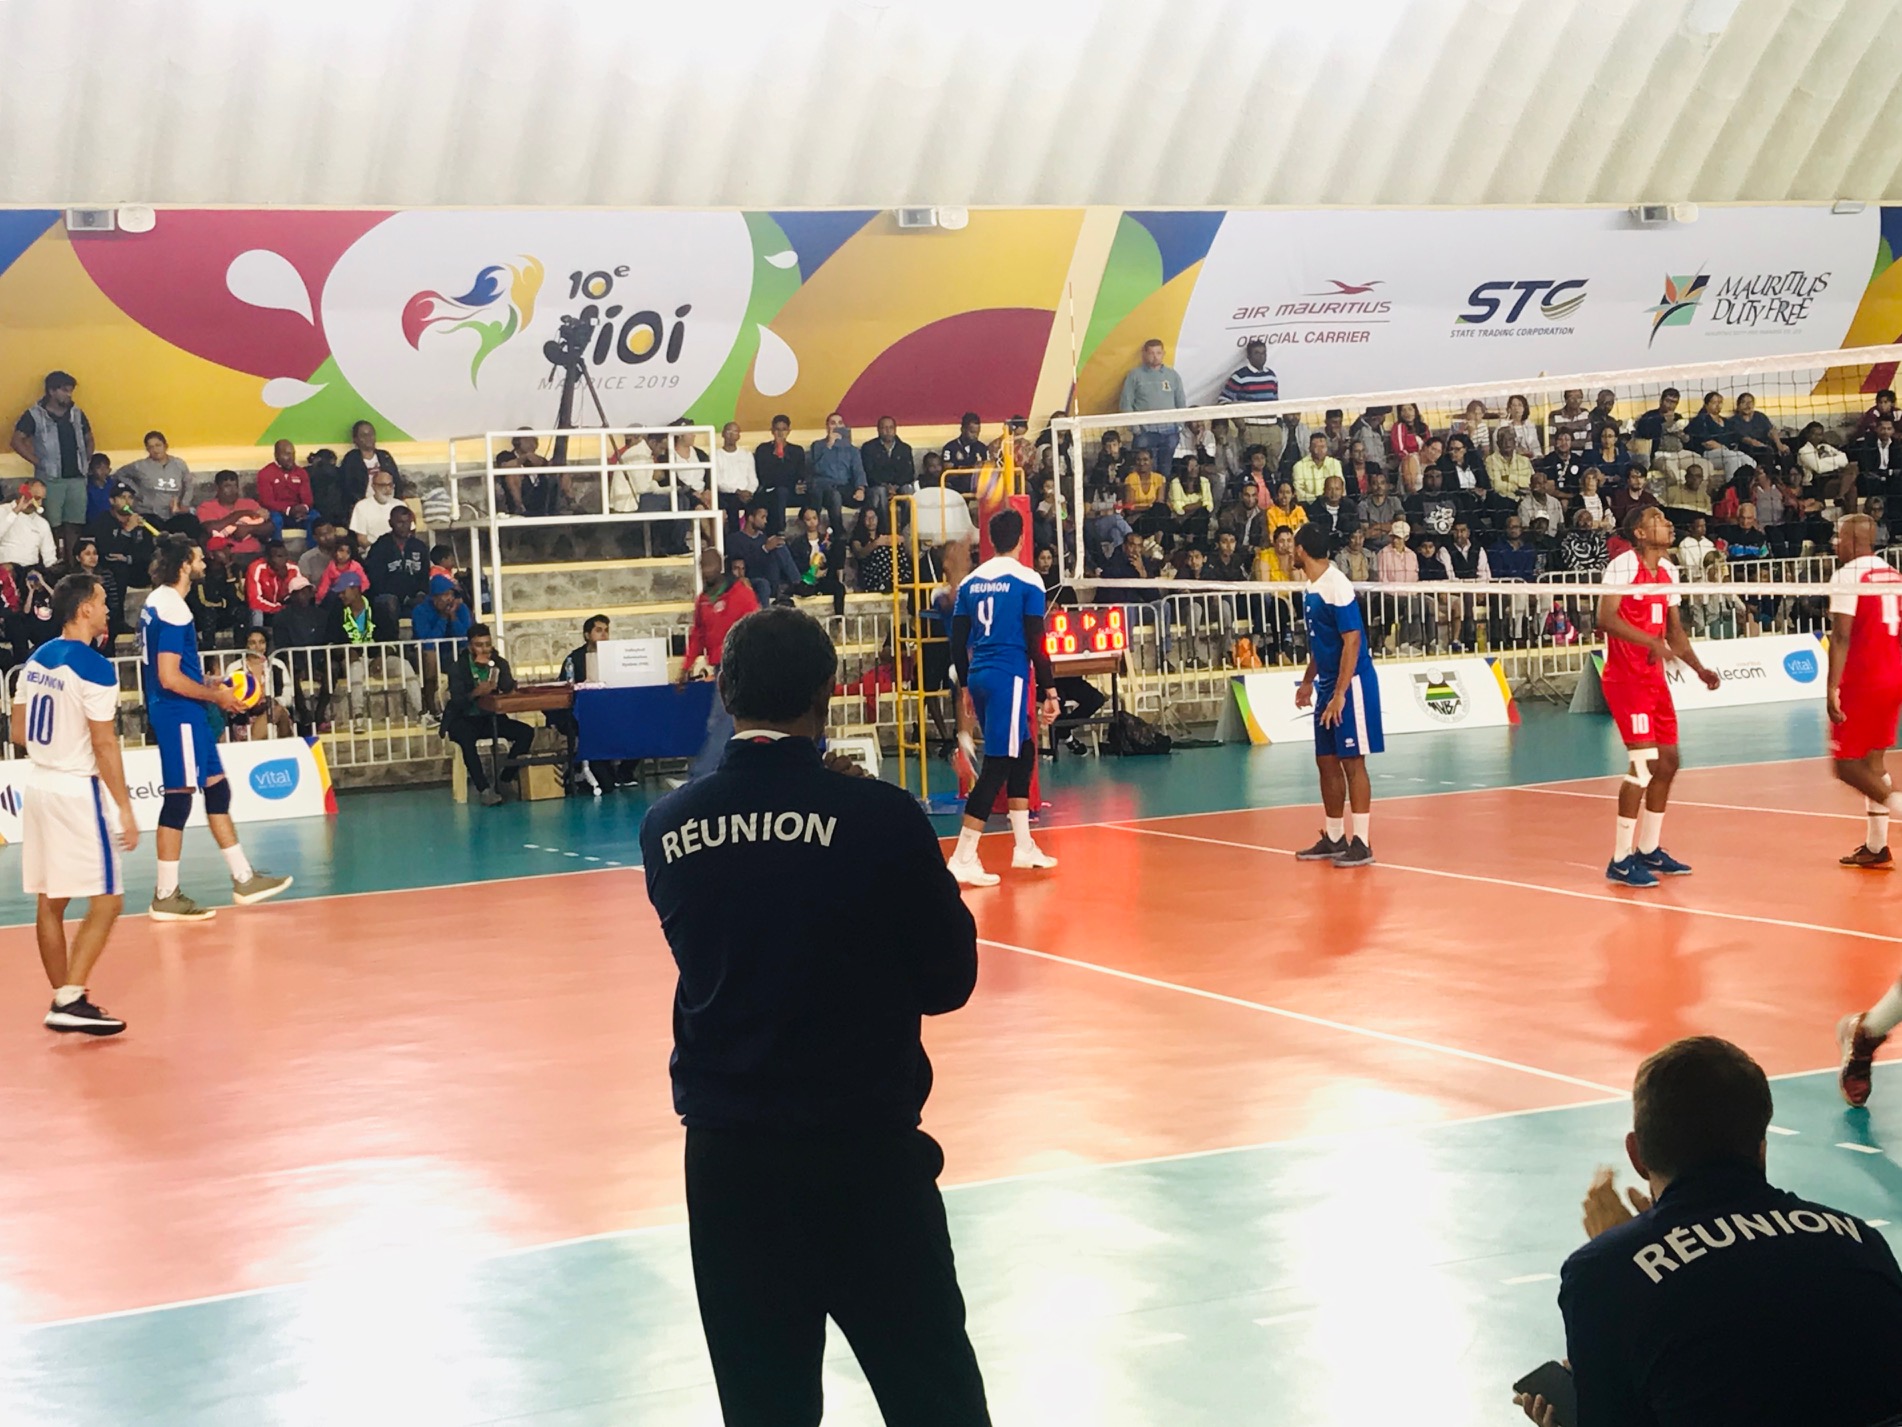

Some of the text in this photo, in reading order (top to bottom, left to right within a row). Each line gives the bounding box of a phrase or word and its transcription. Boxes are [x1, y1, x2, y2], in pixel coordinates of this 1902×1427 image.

[1716, 270, 1832, 300] MAURITIUS
[1456, 278, 1590, 323] STC
[1764, 297, 1814, 326] FREE
[1304, 331, 1371, 344] CARRIER
[1450, 326, 1576, 338] STATE TRADING CORPORATION
[634, 375, 680, 390] 2019
[978, 596, 994, 637] 4
[28, 692, 54, 746] 10
[1630, 713, 1650, 735] 10
[661, 811, 838, 864] RÉUNION
[1632, 1210, 1863, 1284] RÉUNION
